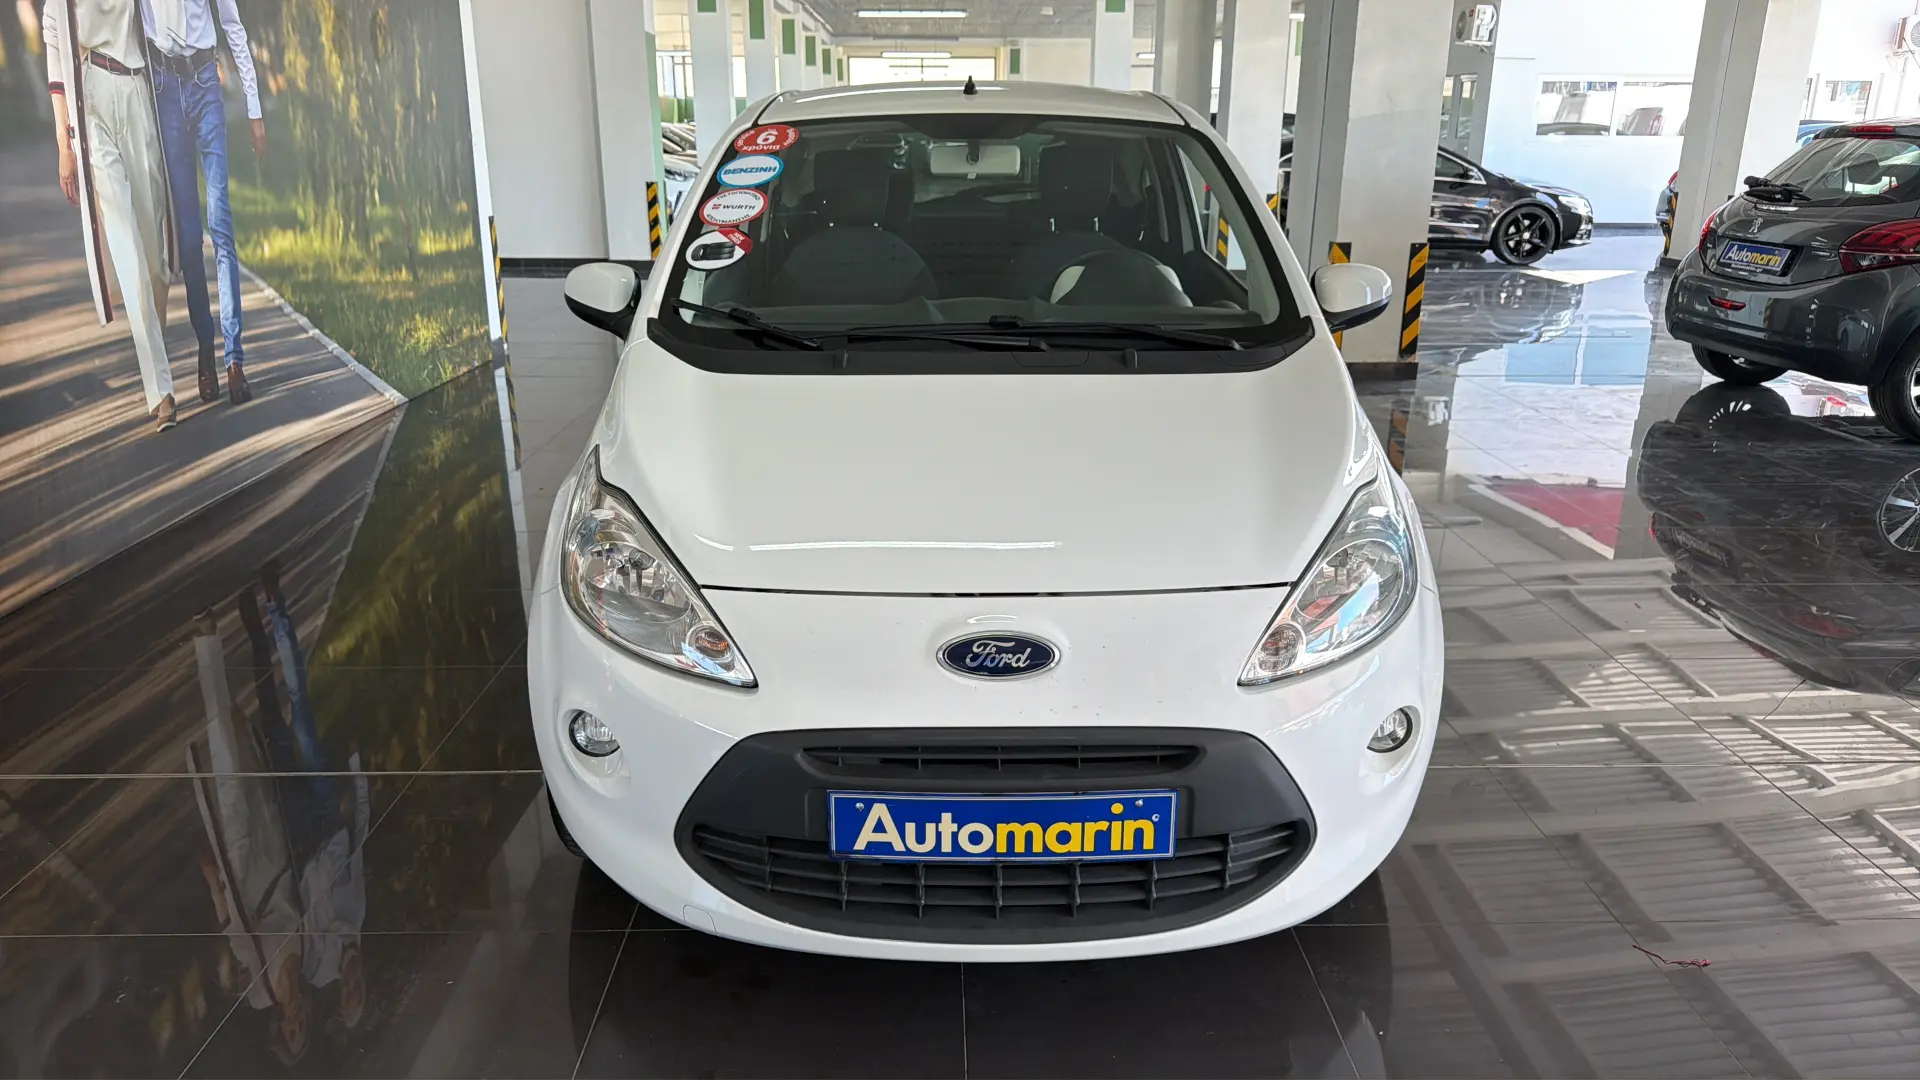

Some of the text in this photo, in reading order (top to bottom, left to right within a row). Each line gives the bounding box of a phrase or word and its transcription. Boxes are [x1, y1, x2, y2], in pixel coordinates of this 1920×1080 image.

[742, 144, 781, 152] χρόνια
[756, 130, 778, 145] 6
[1725, 245, 1782, 267] Automarin
[965, 640, 1032, 668] Ford
[853, 802, 1155, 853] Automarin
